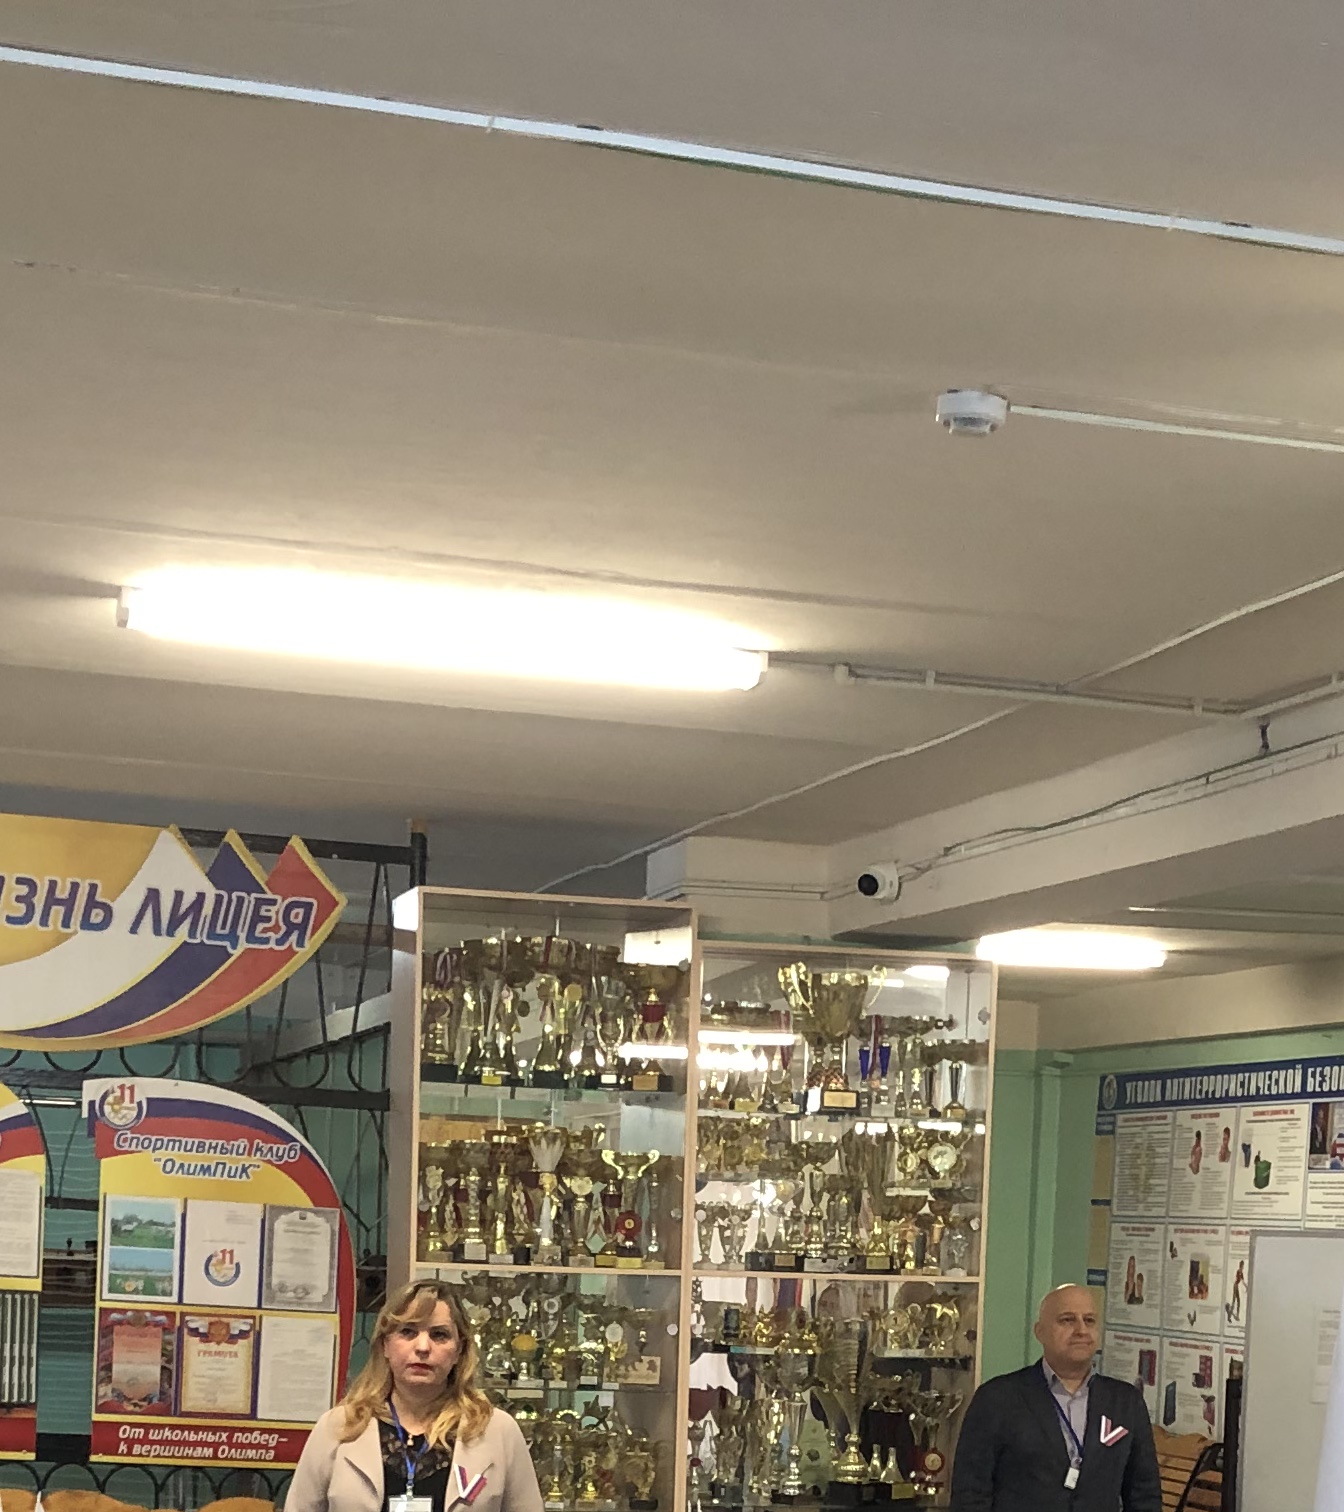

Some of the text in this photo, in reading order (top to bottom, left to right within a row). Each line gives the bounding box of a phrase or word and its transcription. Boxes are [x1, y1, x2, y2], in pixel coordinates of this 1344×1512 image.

[128, 887, 316, 949] ЛИЦЕЯ
[1125, 1079, 1162, 1104] УГОЛОК
[1165, 1064, 1302, 1101] АНТИТЕРРОРИСТИЧЕСКОЙ
[115, 1131, 300, 1161] Спортивный клуб
[118, 1425, 145, 1440] От
[148, 1428, 228, 1444] школьных
[117, 1442, 275, 1461] к вершинам Олимпа
